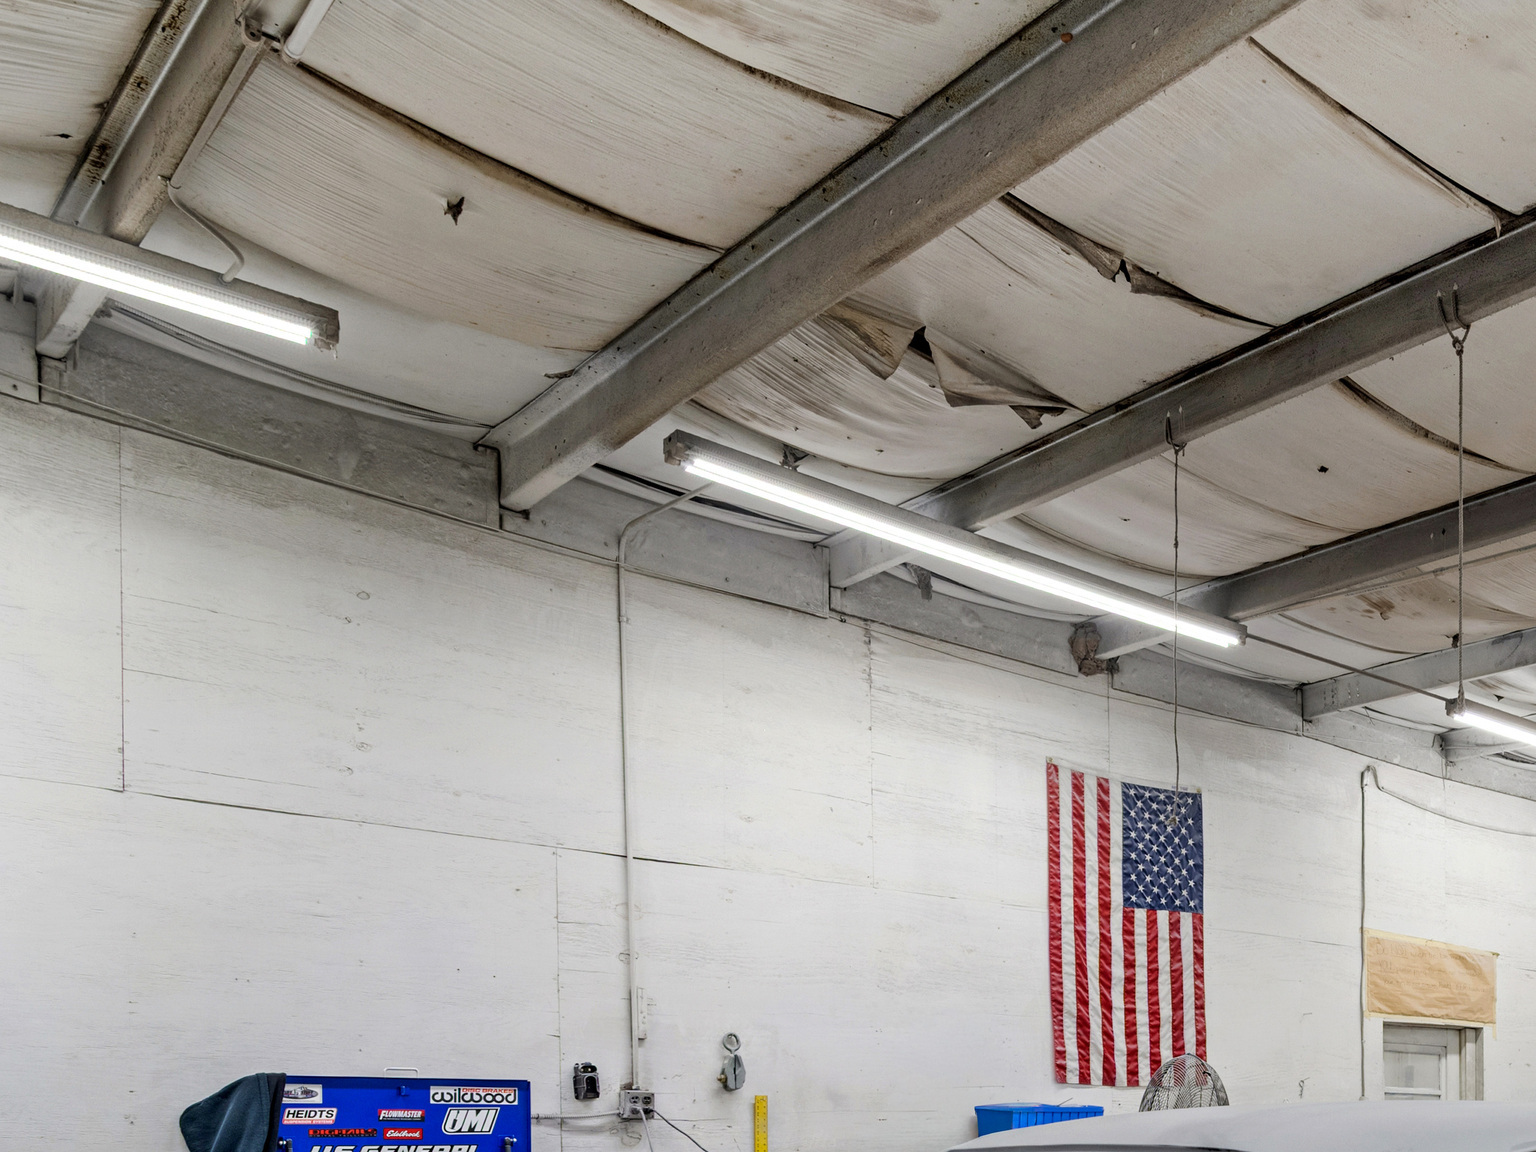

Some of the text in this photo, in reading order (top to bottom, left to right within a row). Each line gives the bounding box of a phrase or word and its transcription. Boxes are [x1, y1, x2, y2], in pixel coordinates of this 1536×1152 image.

[432, 1088, 516, 1103] wilwood
[286, 1110, 334, 1118] HEIDTS
[380, 1110, 422, 1120] FLOWMASTER
[444, 1109, 497, 1132] UMI
[386, 1128, 420, 1138] Edelbrock
